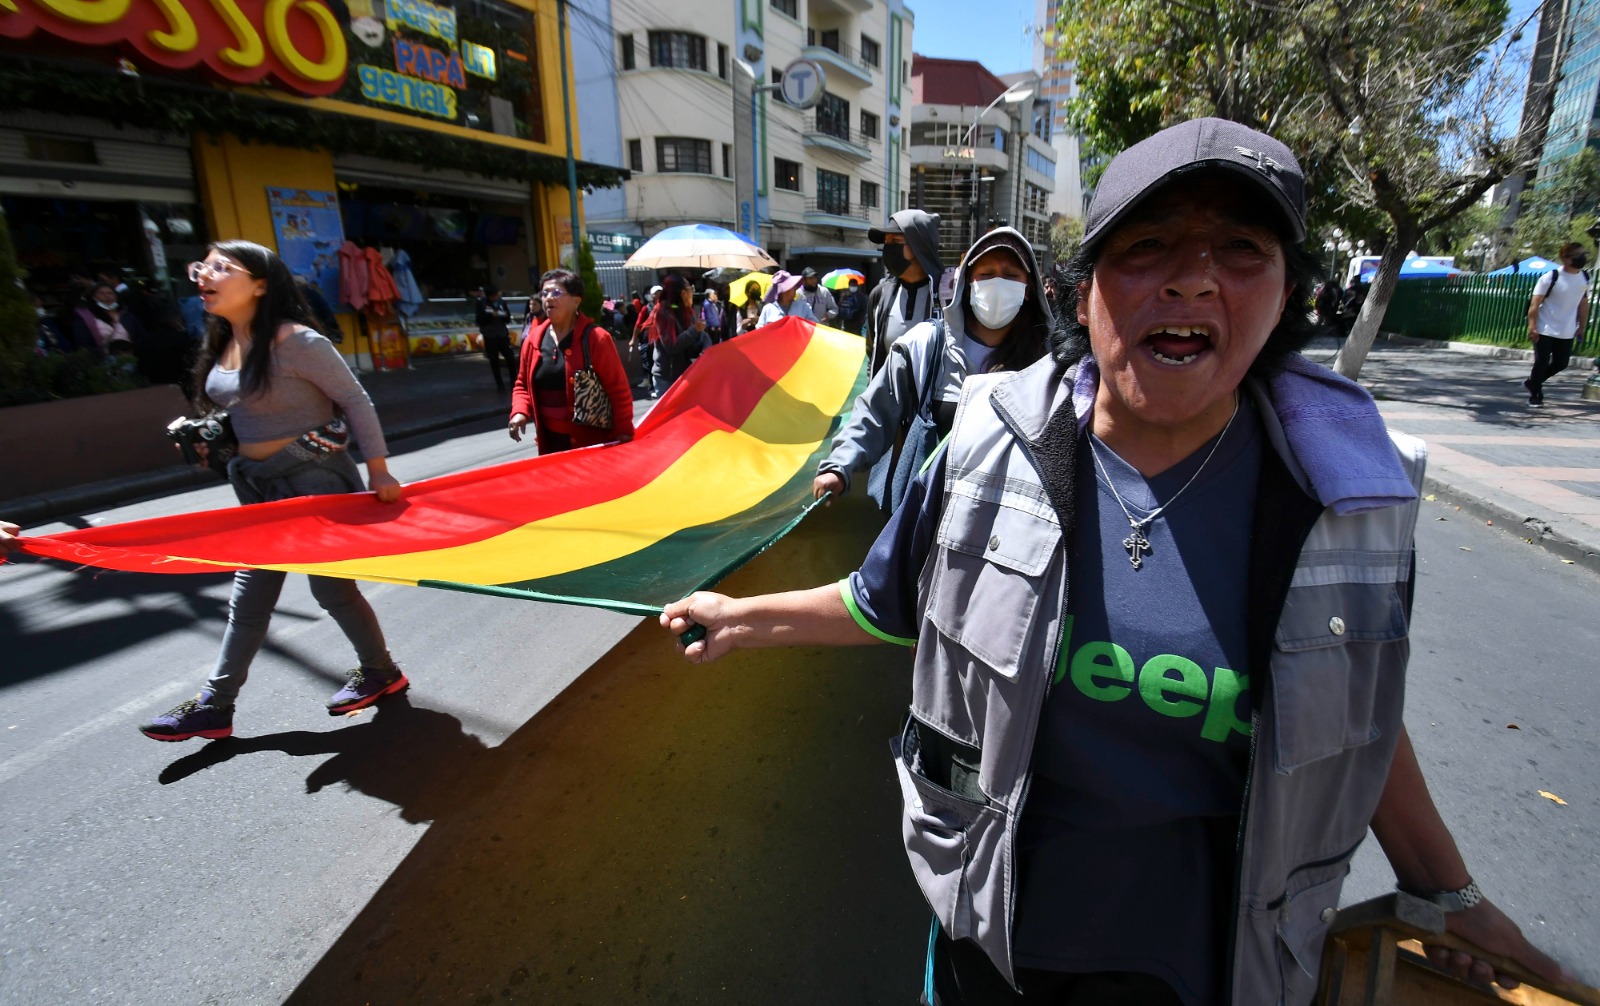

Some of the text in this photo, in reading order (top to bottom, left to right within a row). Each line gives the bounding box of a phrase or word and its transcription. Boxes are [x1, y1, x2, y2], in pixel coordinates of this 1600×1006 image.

[462, 41, 496, 79] un
[790, 70, 812, 100] T
[596, 234, 632, 247] CELESTE
